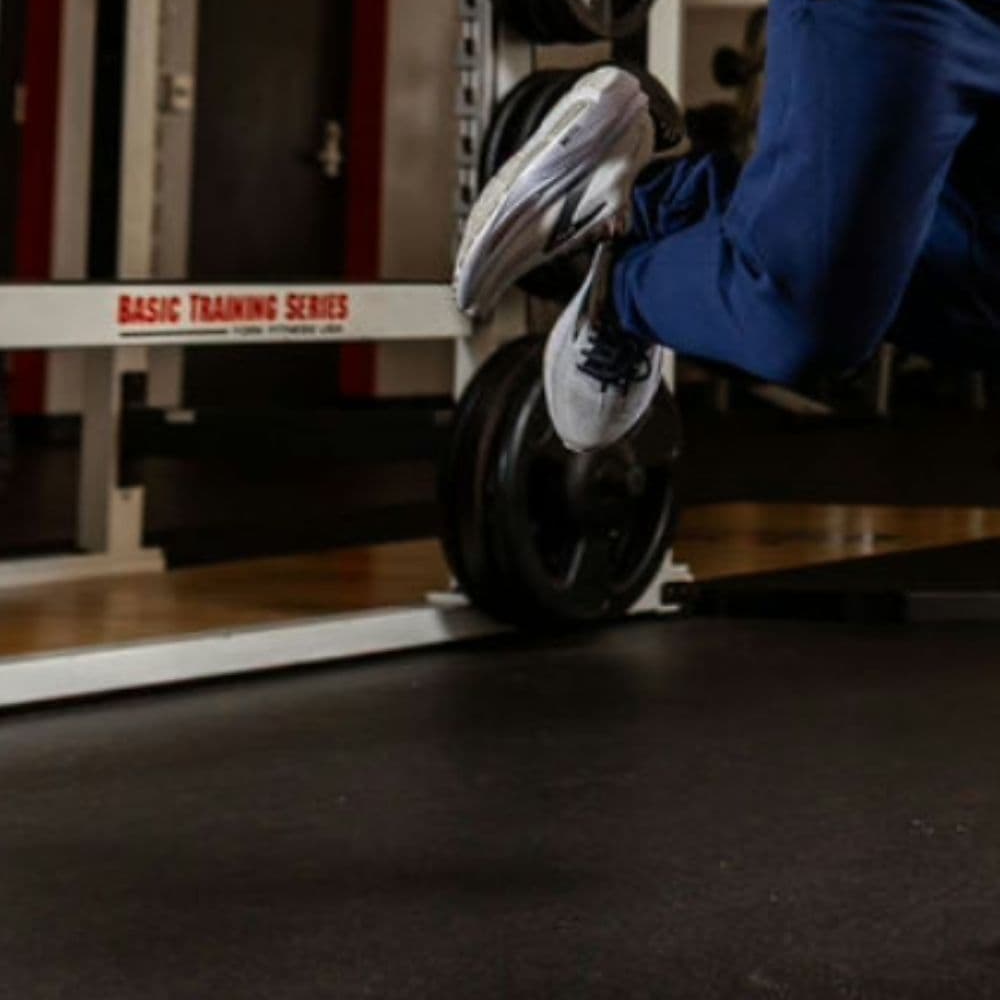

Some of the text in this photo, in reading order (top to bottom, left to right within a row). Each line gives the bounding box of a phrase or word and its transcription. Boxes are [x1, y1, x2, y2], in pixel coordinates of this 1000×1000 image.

[118, 292, 349, 323] BASIC TRAINING SERIES
